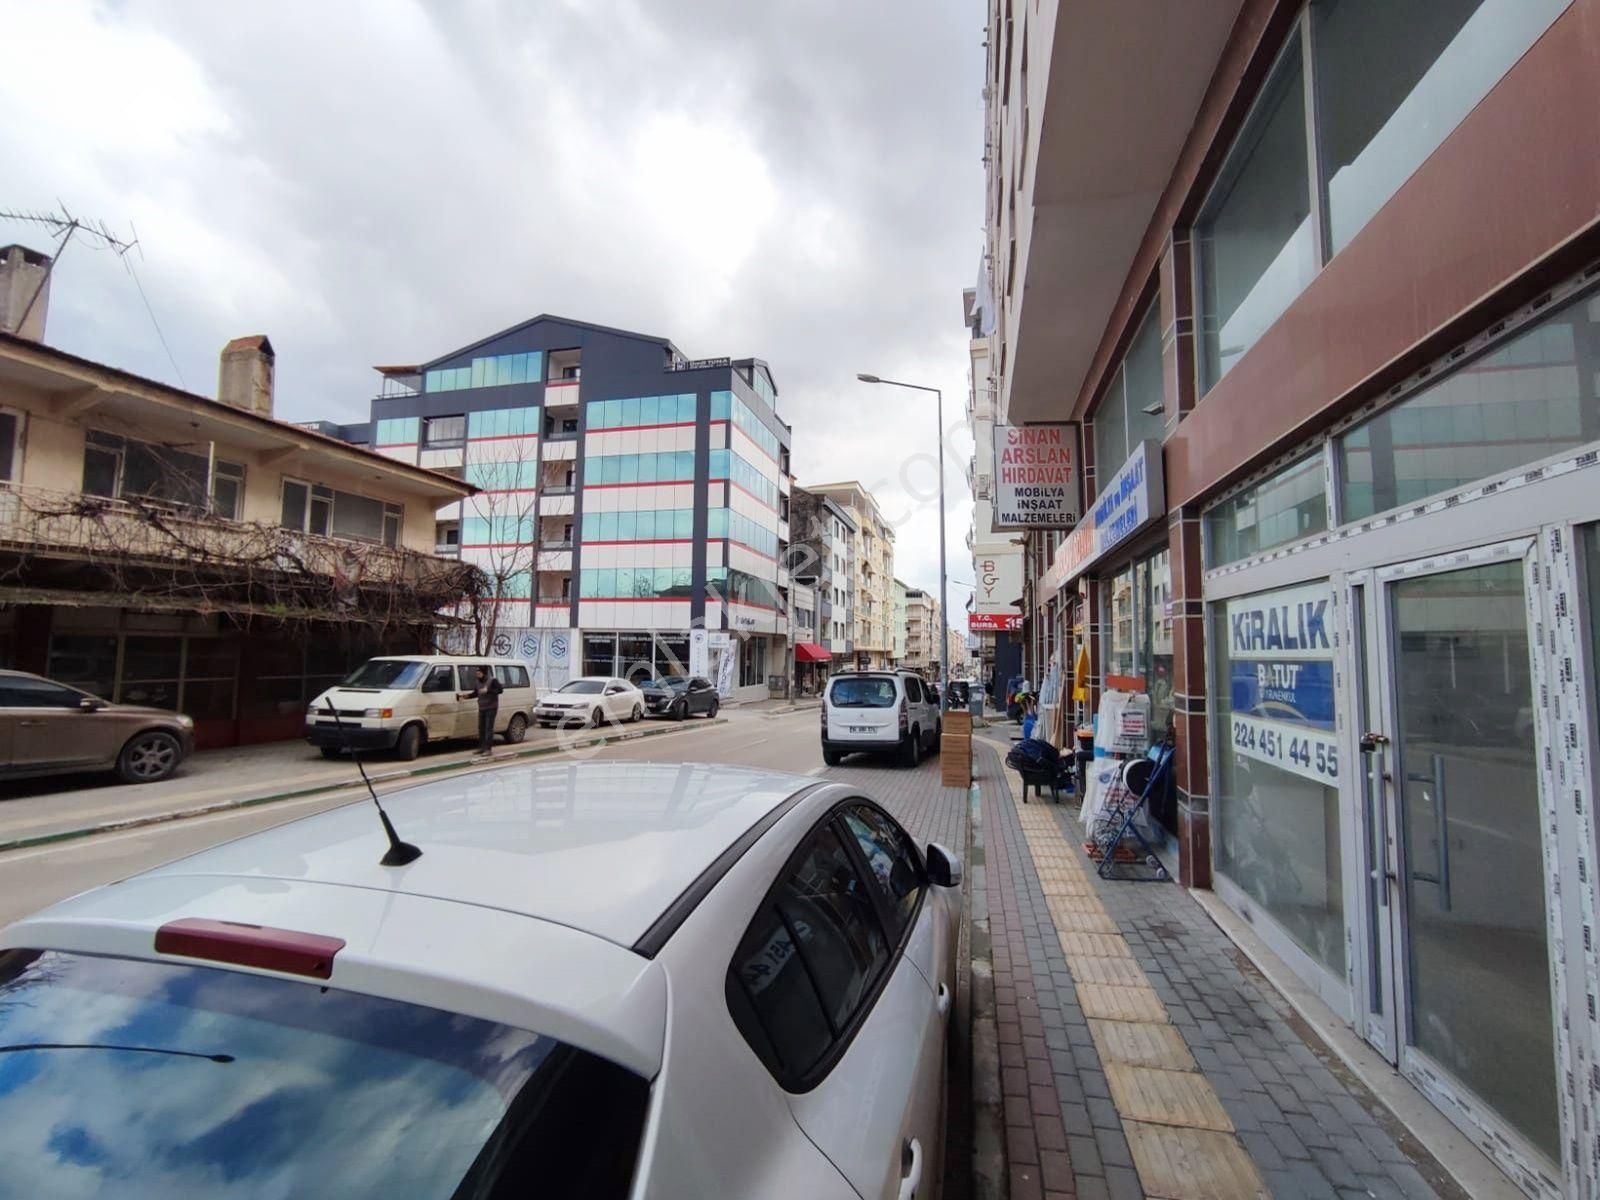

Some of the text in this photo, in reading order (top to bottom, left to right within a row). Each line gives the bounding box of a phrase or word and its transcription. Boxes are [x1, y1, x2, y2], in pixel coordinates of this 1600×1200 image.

[1001, 447, 1072, 465] ARSLAN
[1002, 467, 1073, 485] HIRDAVAT
[970, 621, 999, 629] BURSA
[1257, 663, 1299, 690] BATUT
[1233, 722, 1339, 778] 224 451 44 55
